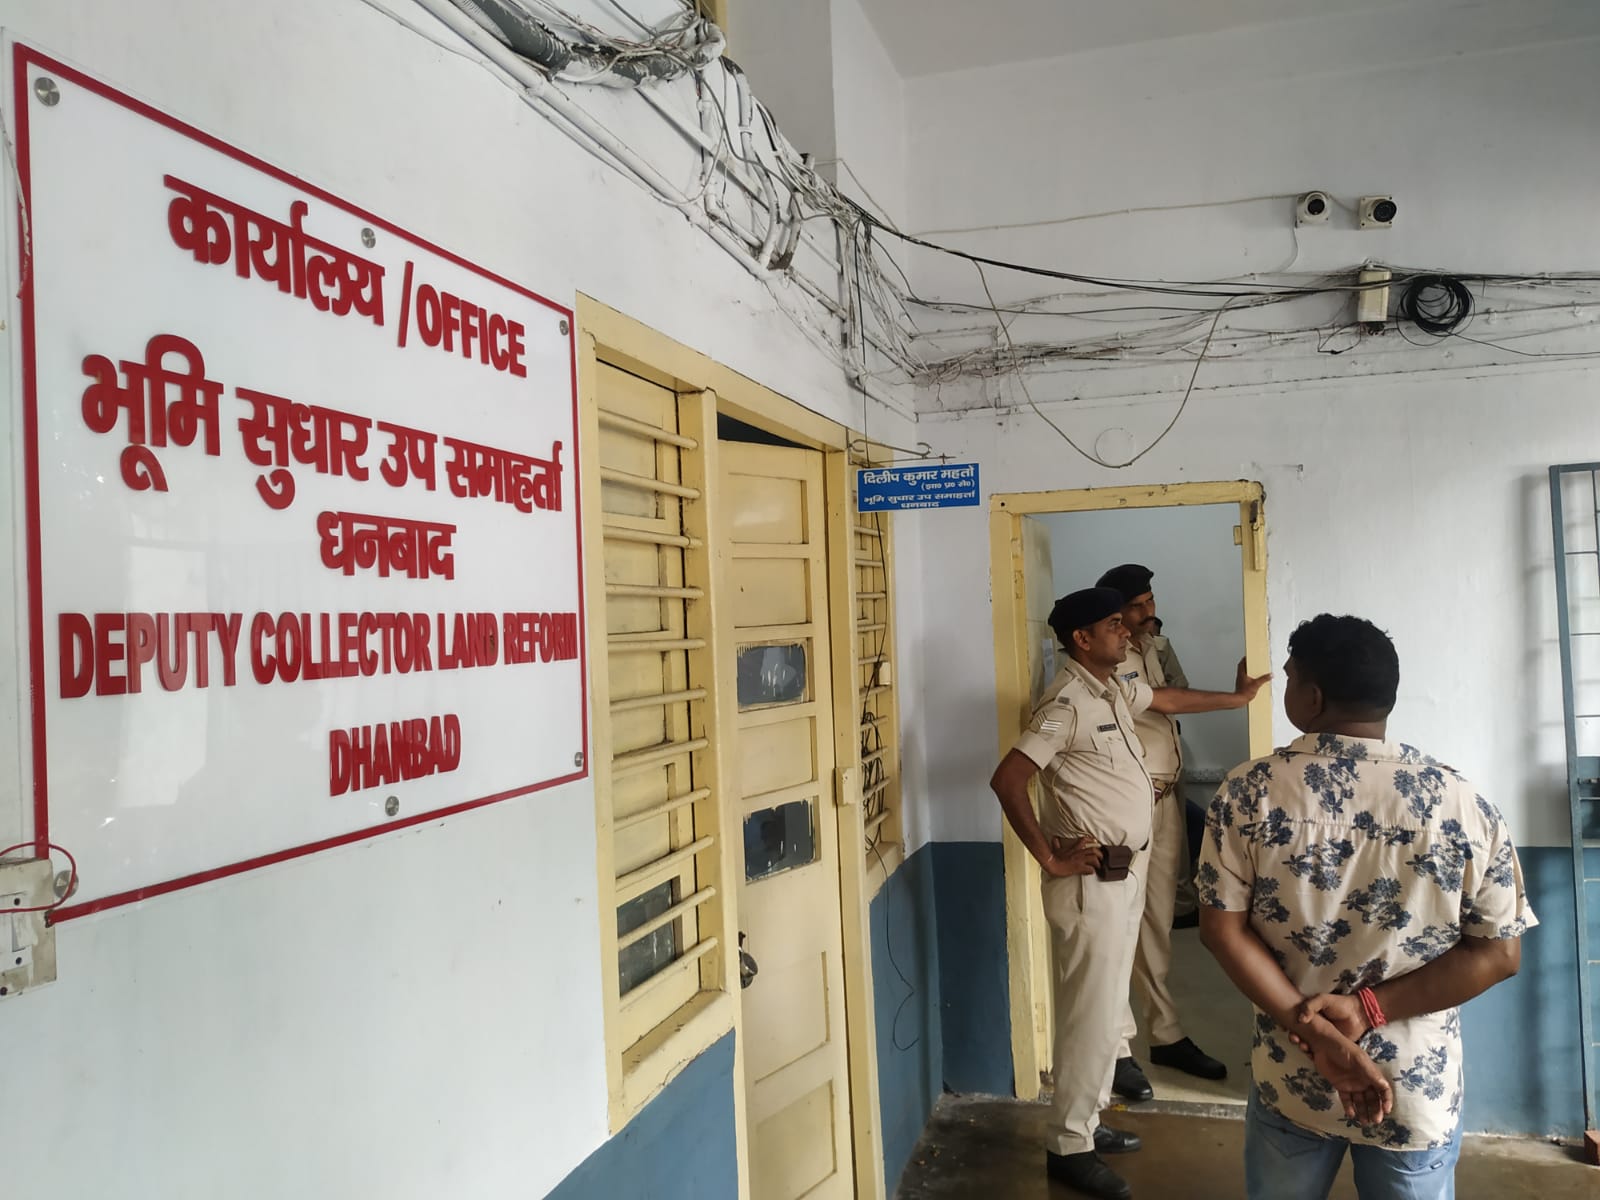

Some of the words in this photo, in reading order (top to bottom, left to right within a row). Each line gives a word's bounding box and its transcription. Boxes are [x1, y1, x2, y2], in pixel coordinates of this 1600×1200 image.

[164, 174, 386, 327] कार्यालय
[81, 334, 225, 492] भूमि
[235, 387, 373, 510] सुधार
[377, 420, 439, 492] उप
[443, 437, 563, 514] समाहर्ता
[863, 471, 899, 484] दिलीप
[903, 471, 938, 485] कुमार
[940, 465, 974, 478] महतो
[316, 511, 457, 581] धनबाद
[59, 612, 243, 699] DEPUTY
[250, 612, 433, 685] COLLECTOR
[437, 612, 499, 671] LAND
[503, 612, 579, 666] REFORM
[329, 713, 461, 797] DHANBAD
